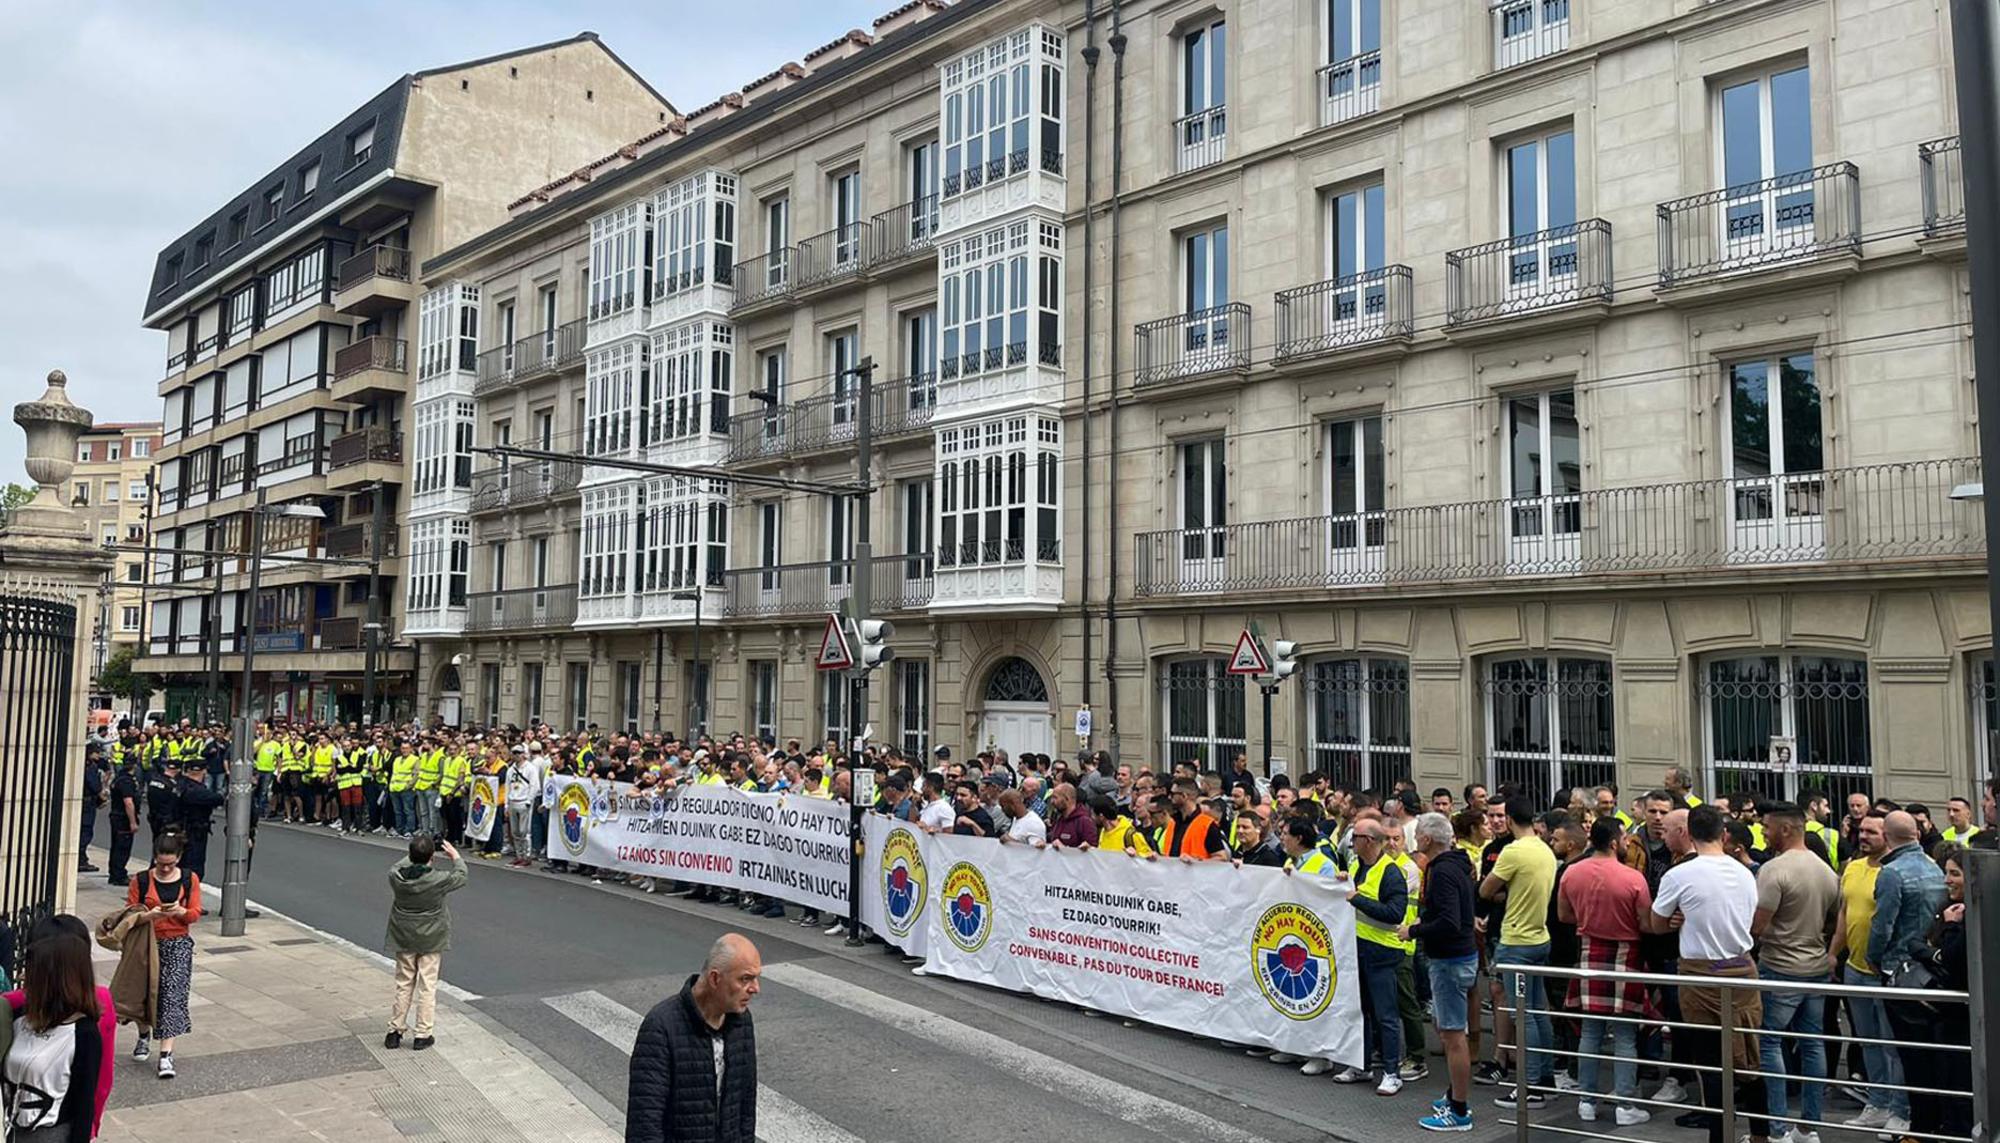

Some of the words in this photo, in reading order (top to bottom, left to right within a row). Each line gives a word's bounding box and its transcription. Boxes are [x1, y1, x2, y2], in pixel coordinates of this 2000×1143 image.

[780, 810, 798, 828] NO
[801, 812, 825, 833] HAY
[828, 816, 851, 838] TOU
[617, 845, 628, 861] 12
[659, 849, 676, 867] SIN
[678, 851, 733, 873] CONVENIO
[681, 821, 717, 840] DUINIK
[746, 828, 761, 846] EZ
[763, 831, 793, 853] DAGO
[794, 837, 850, 865] TOURRIK!
[799, 872, 814, 893] EN
[816, 877, 850, 902] LUCH
[1045, 885, 1104, 906] HITZARMEN
[1105, 894, 1144, 911] DUINIK
[1147, 899, 1182, 918] GABE,
[1063, 908, 1076, 921] EZ
[1077, 911, 1107, 926] DAGO
[1108, 915, 1161, 935] TOURRIK!
[1261, 905, 1293, 927] ACUERDO
[1296, 907, 1331, 955] REGULADOR
[1264, 925, 1275, 942] NO
[1277, 917, 1296, 929] HAY
[1298, 921, 1325, 950] TOUR
[1029, 926, 1057, 942] SANS
[1058, 931, 1128, 955] CONVENTION
[1129, 944, 1199, 968] COLLECTIVE
[1084, 957, 1105, 972] PAS
[1106, 961, 1121, 975] DU
[1123, 965, 1154, 983] TOUR
[1155, 971, 1171, 986] DE
[1172, 974, 1225, 997] FRANCE!
[1298, 1003, 1309, 1011] EN
